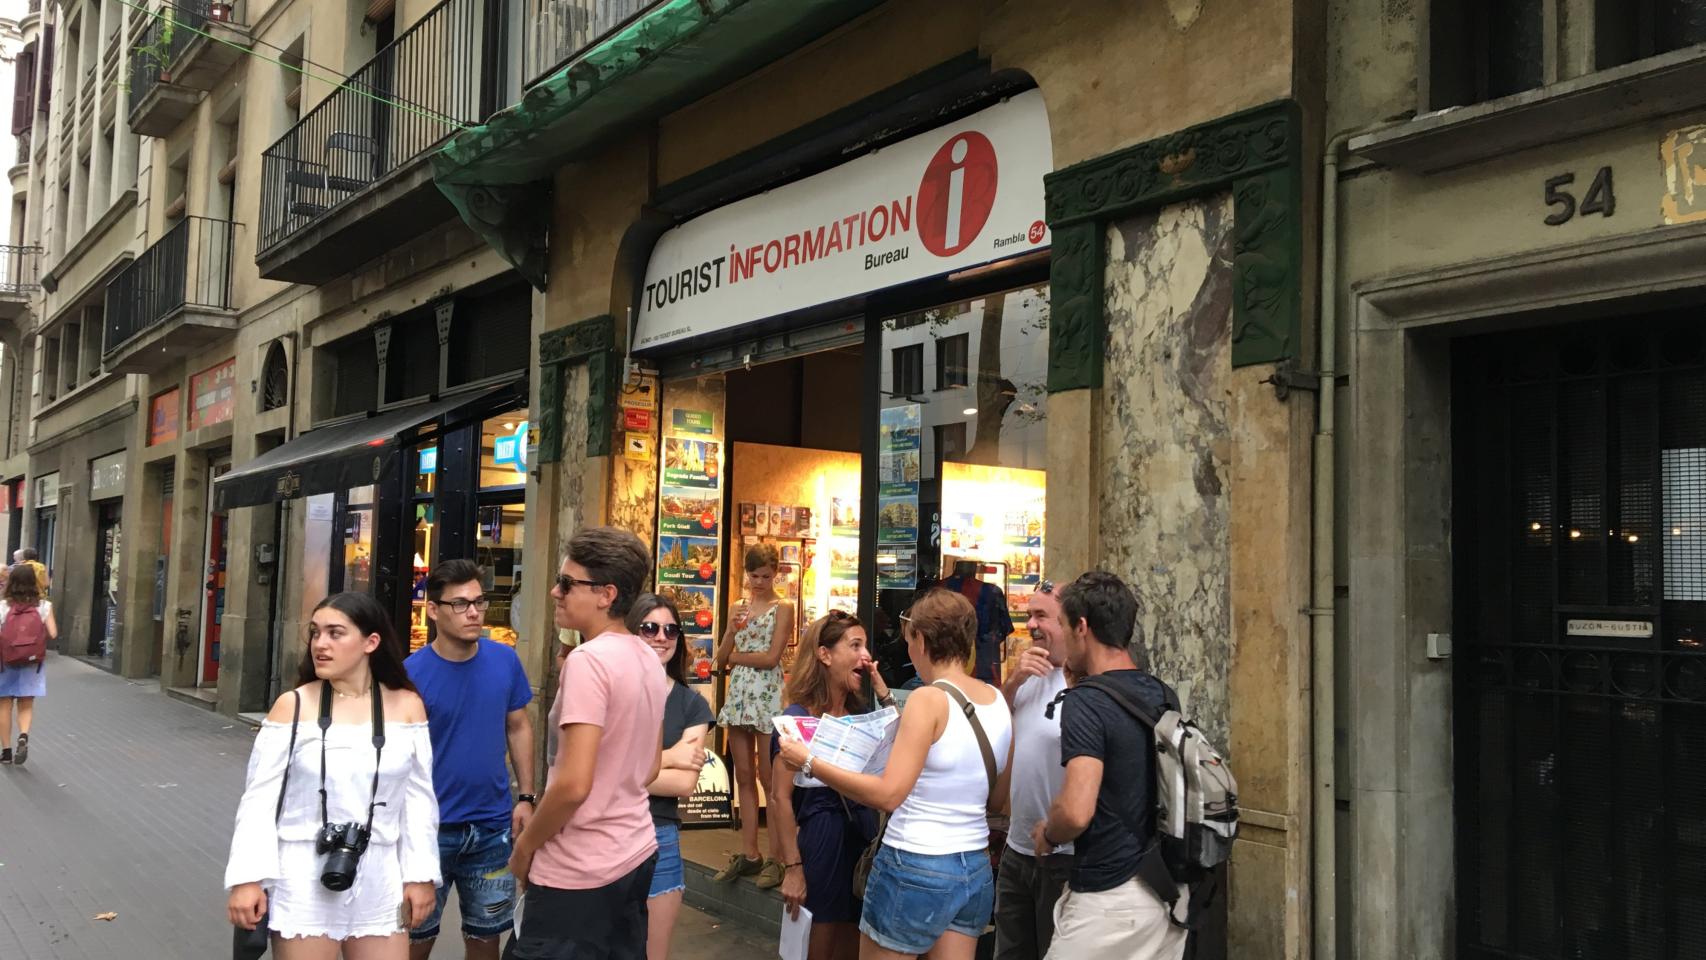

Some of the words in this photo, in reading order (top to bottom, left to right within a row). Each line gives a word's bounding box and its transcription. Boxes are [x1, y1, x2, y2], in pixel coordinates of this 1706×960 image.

[1543, 165, 1616, 226] 54
[993, 232, 1026, 249] Rambla
[1030, 224, 1044, 240] 54
[864, 246, 909, 271] Bureau
[646, 256, 726, 312] TOURIST
[666, 472, 689, 480] Sagrada
